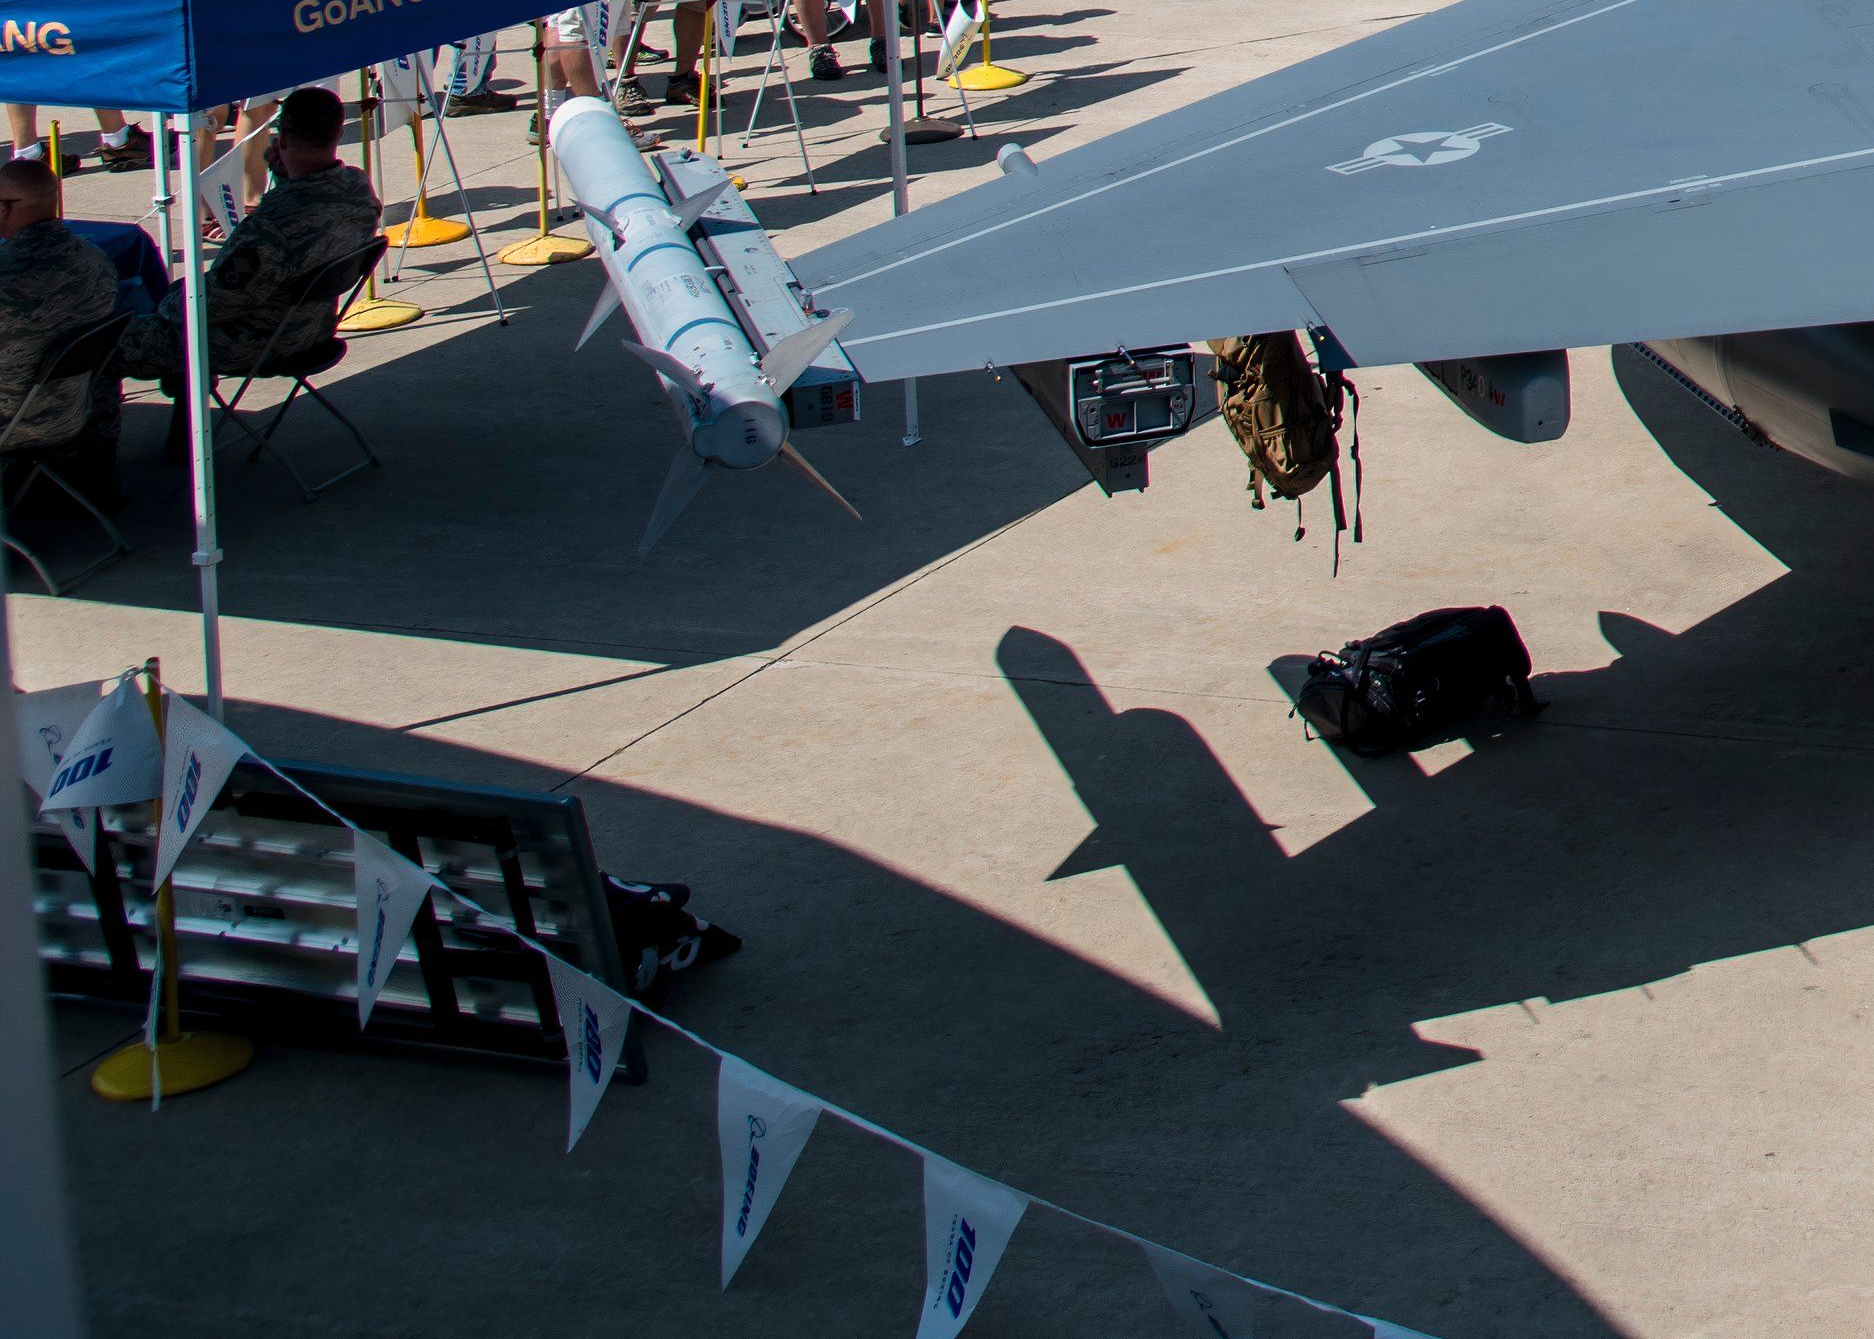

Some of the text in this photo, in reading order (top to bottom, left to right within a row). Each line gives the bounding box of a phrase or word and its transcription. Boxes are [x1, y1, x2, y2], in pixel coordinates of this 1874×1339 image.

[1106, 411, 1128, 429] W
[50, 746, 117, 799] 100
[177, 748, 202, 834] 100
[368, 906, 385, 989] BOEING
[585, 1001, 602, 1085] 100
[737, 1143, 761, 1238] BOEING
[946, 1216, 977, 1320] 100
